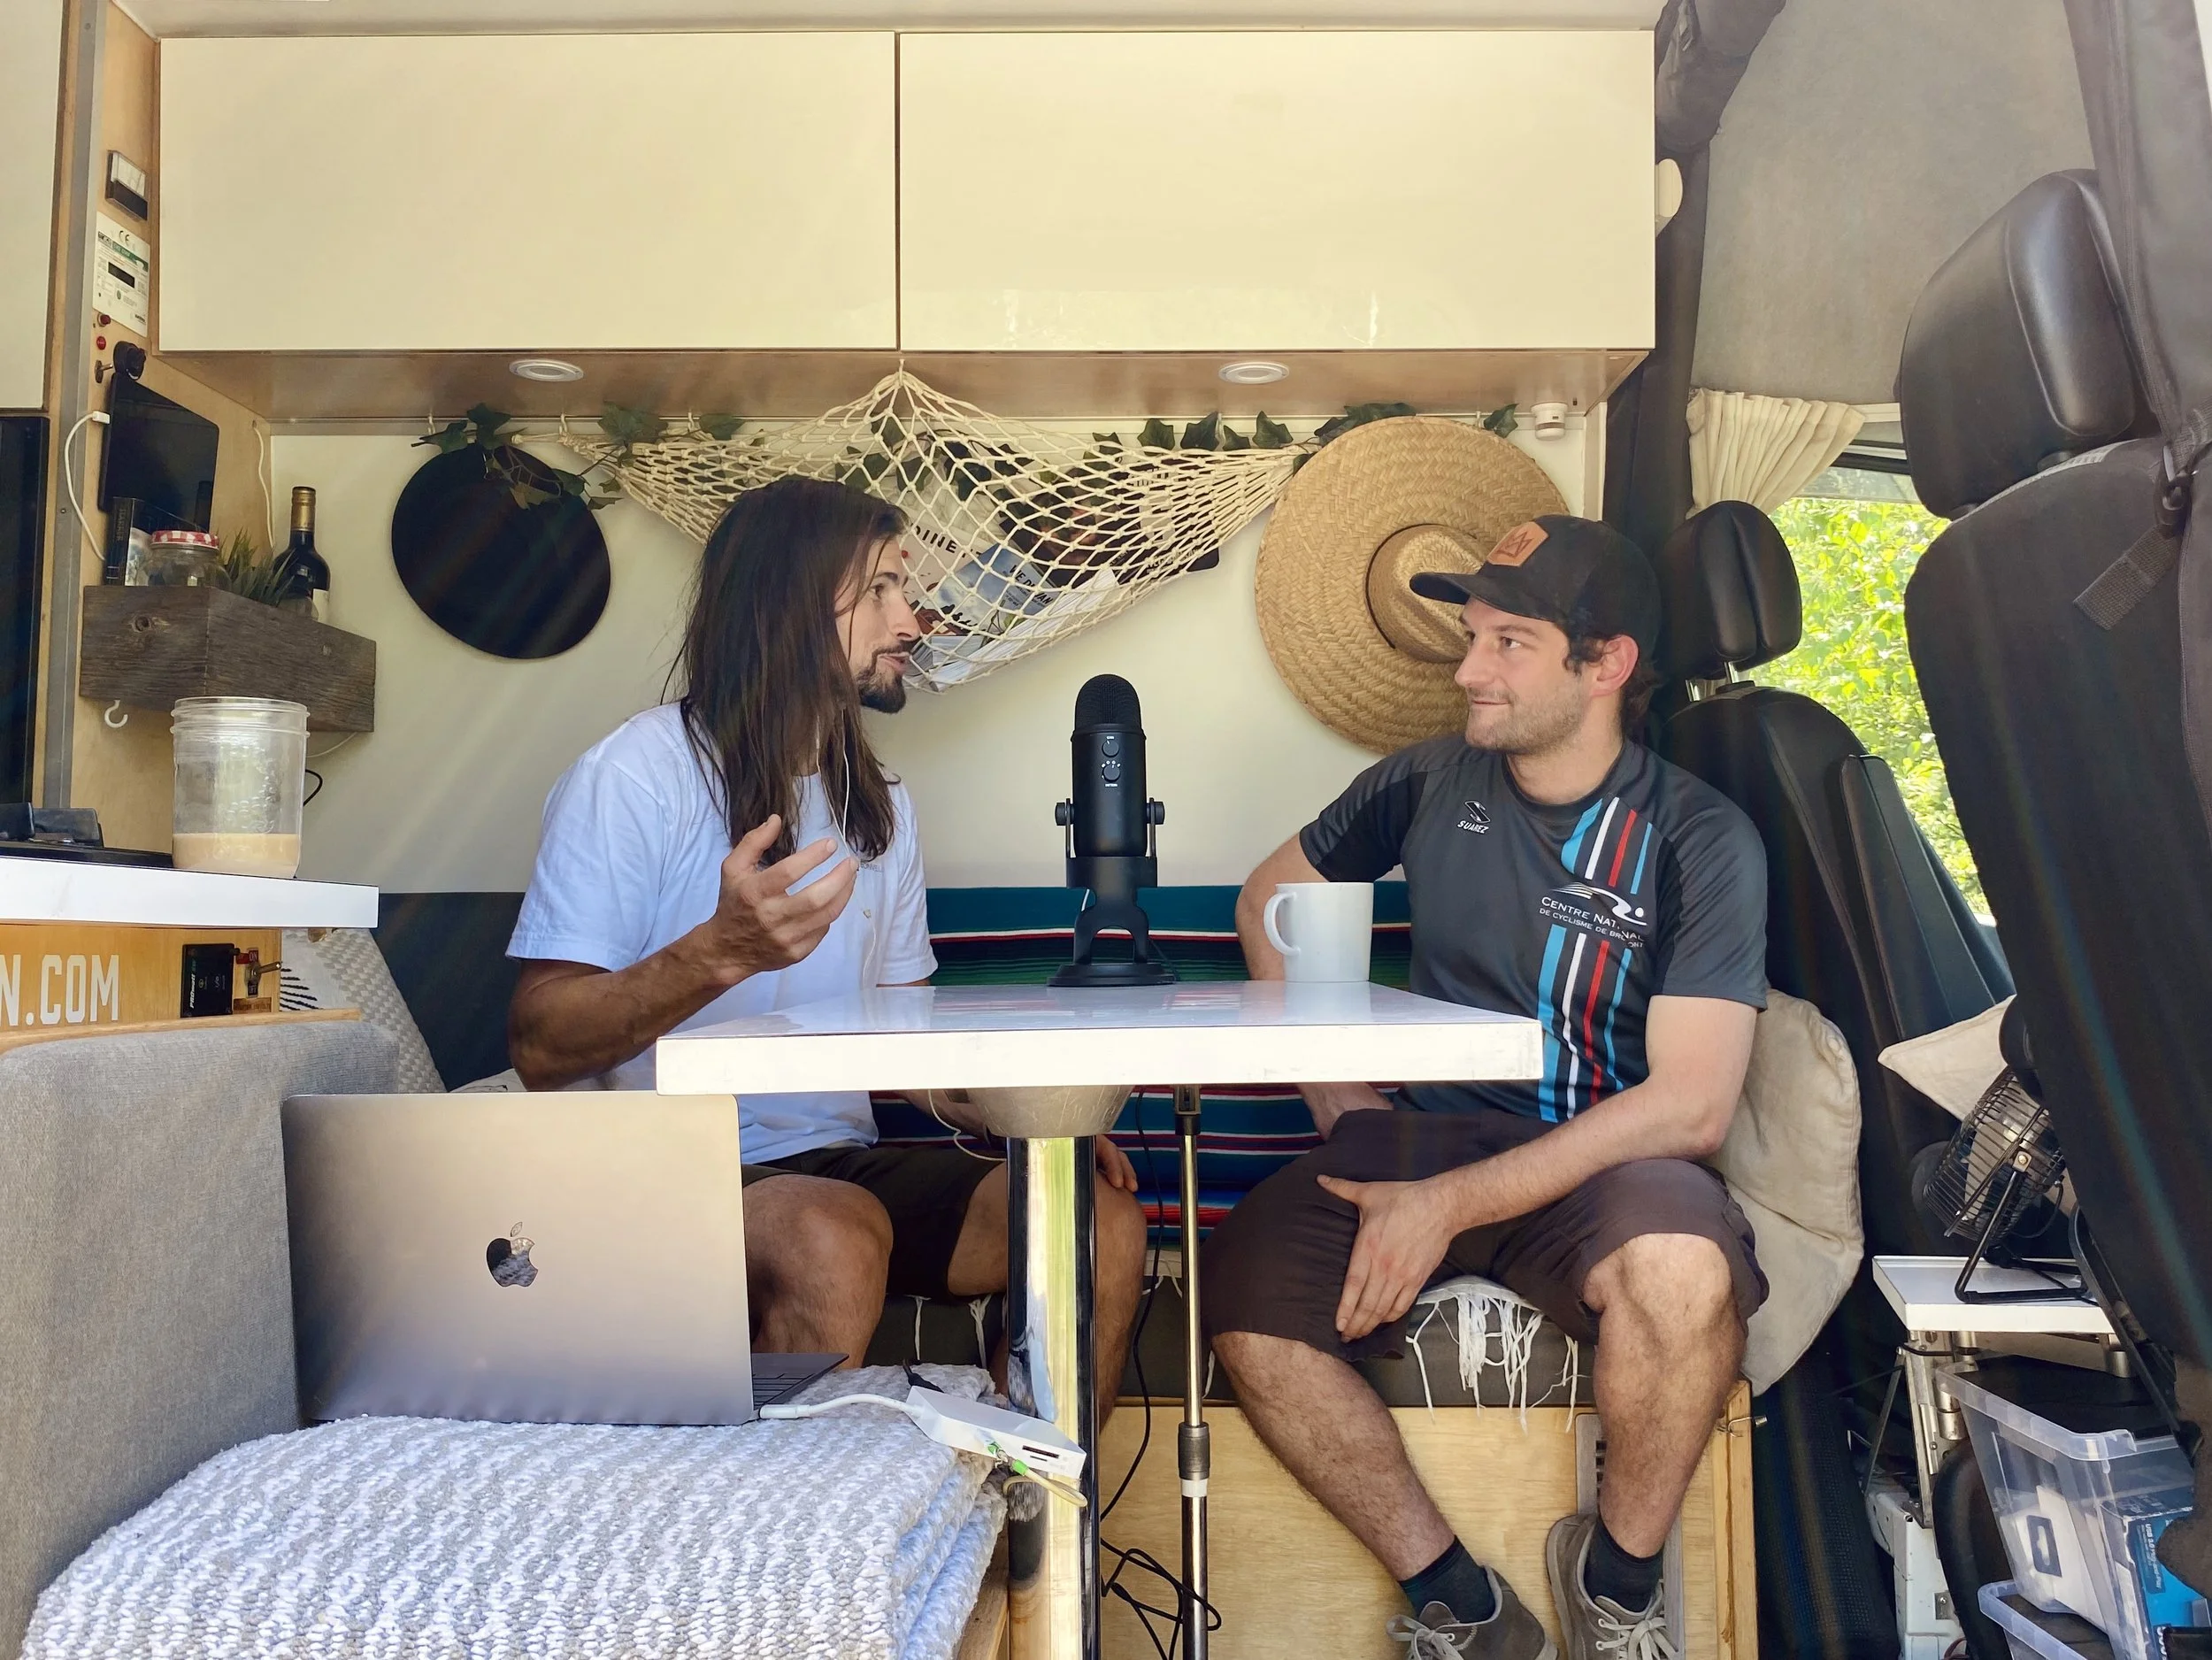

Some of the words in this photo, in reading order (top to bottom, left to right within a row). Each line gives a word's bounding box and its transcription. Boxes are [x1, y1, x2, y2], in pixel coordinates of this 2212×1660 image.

[1456, 820, 1490, 834] SUAREZ
[1541, 896, 1591, 919] CENTRE
[1539, 908, 1551, 917] DE
[1552, 912, 1594, 930] CYCLISME
[1594, 926, 1607, 934] DE
[249, 951, 257, 962] ON
[2145, 1523, 2154, 1538] USB
